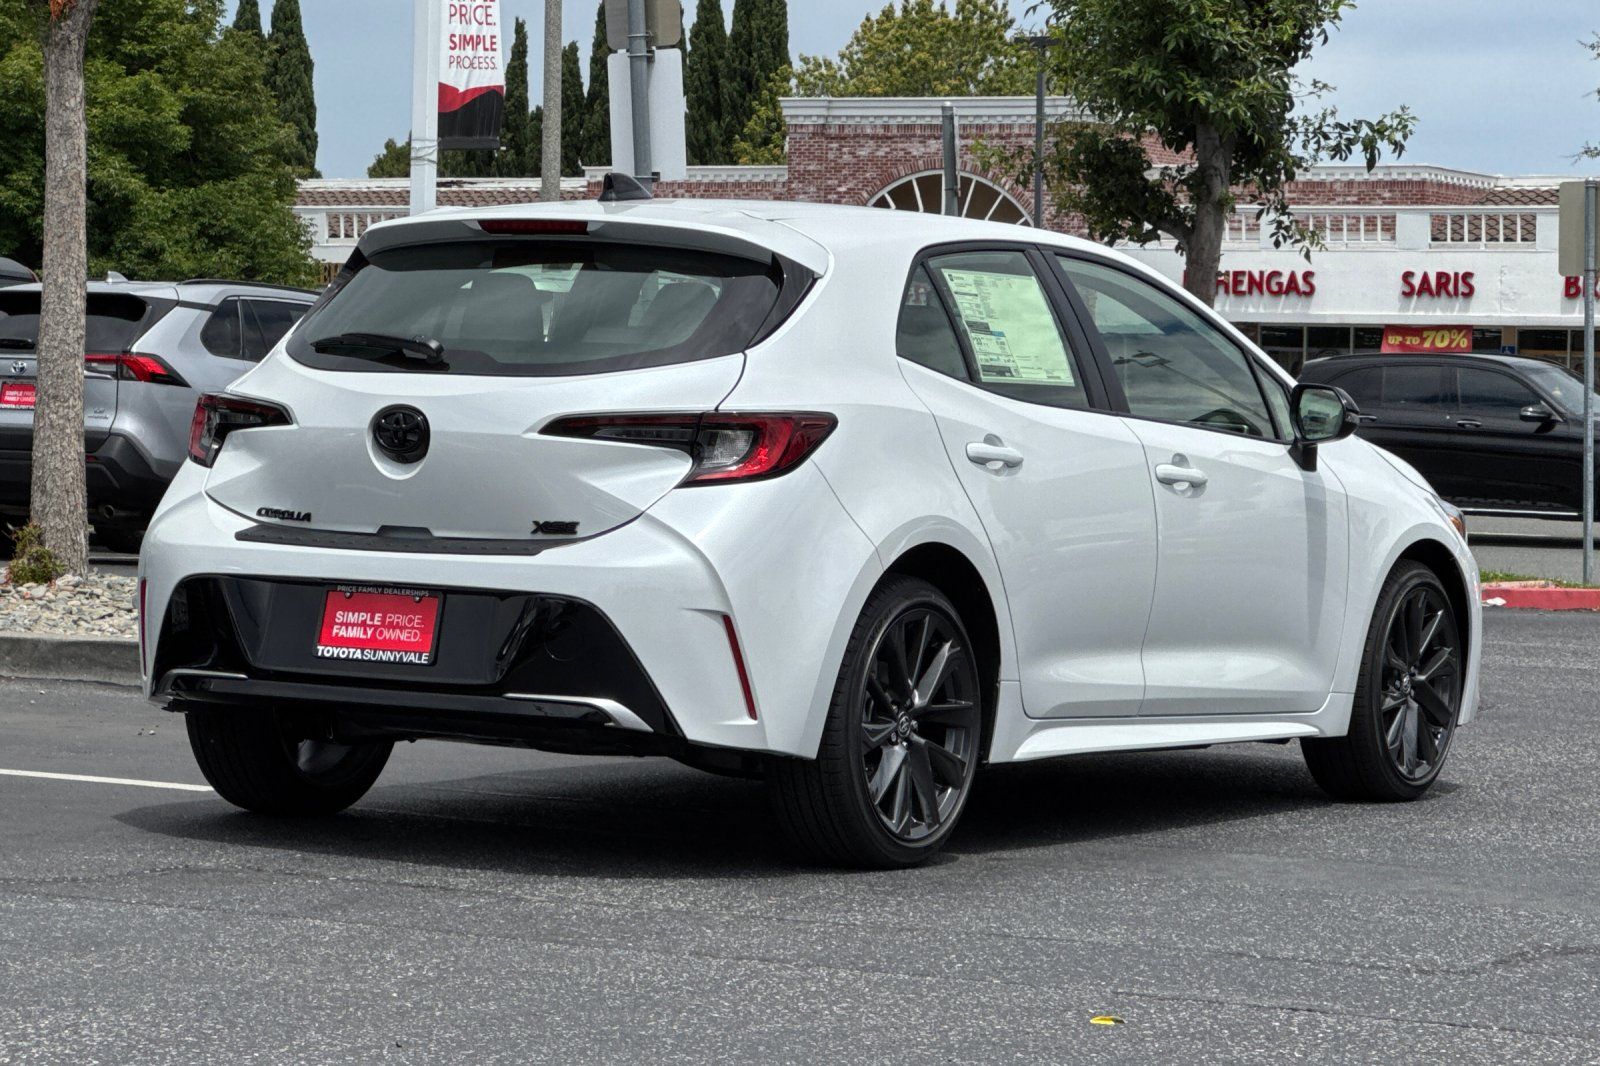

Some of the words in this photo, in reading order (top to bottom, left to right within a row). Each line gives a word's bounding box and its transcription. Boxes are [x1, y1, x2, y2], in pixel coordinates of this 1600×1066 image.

[449, 4, 496, 26] PRICE.
[449, 33, 497, 51] SIMPLE
[449, 55, 498, 70] PROCESS.
[1183, 270, 1316, 297] HENGAS
[1401, 270, 1475, 298] SARIS
[1387, 335, 1403, 345] UP
[1405, 336, 1420, 345] TO
[1422, 329, 1468, 348] 70%
[256, 507, 312, 522] COROLLA
[530, 520, 580, 535] XSE
[337, 585, 357, 593] PRICE
[358, 586, 382, 594] FAMILY
[383, 588, 429, 597] DEALERSHIPS
[335, 611, 382, 626] SIMPLE
[385, 613, 425, 628] PRICE.
[332, 625, 374, 639] FAMILY
[376, 627, 422, 642] OWNED.
